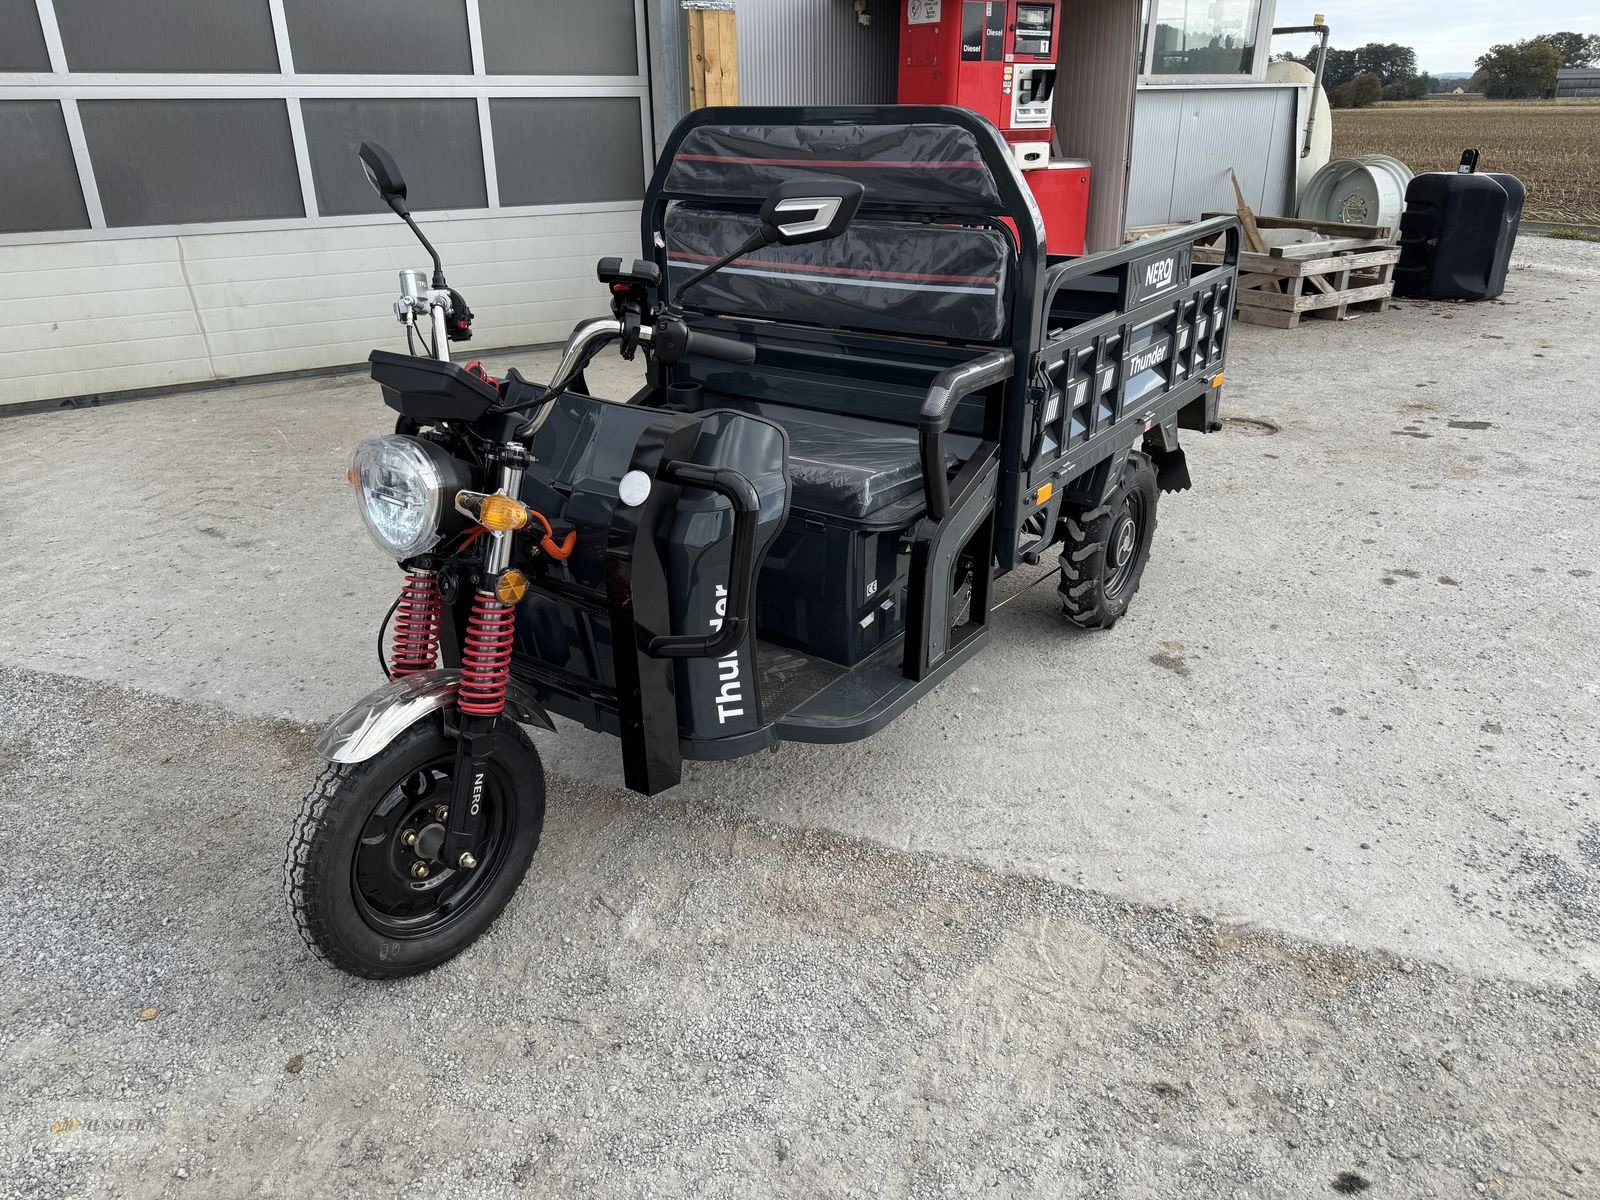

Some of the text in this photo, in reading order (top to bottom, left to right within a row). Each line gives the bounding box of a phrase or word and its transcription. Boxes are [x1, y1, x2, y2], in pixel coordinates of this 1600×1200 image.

[986, 28, 1003, 37] Diesel
[963, 44, 981, 53] Diesel
[1145, 257, 1173, 287] NERO
[1129, 345, 1167, 376] Thunder
[470, 773, 484, 816] NERO
